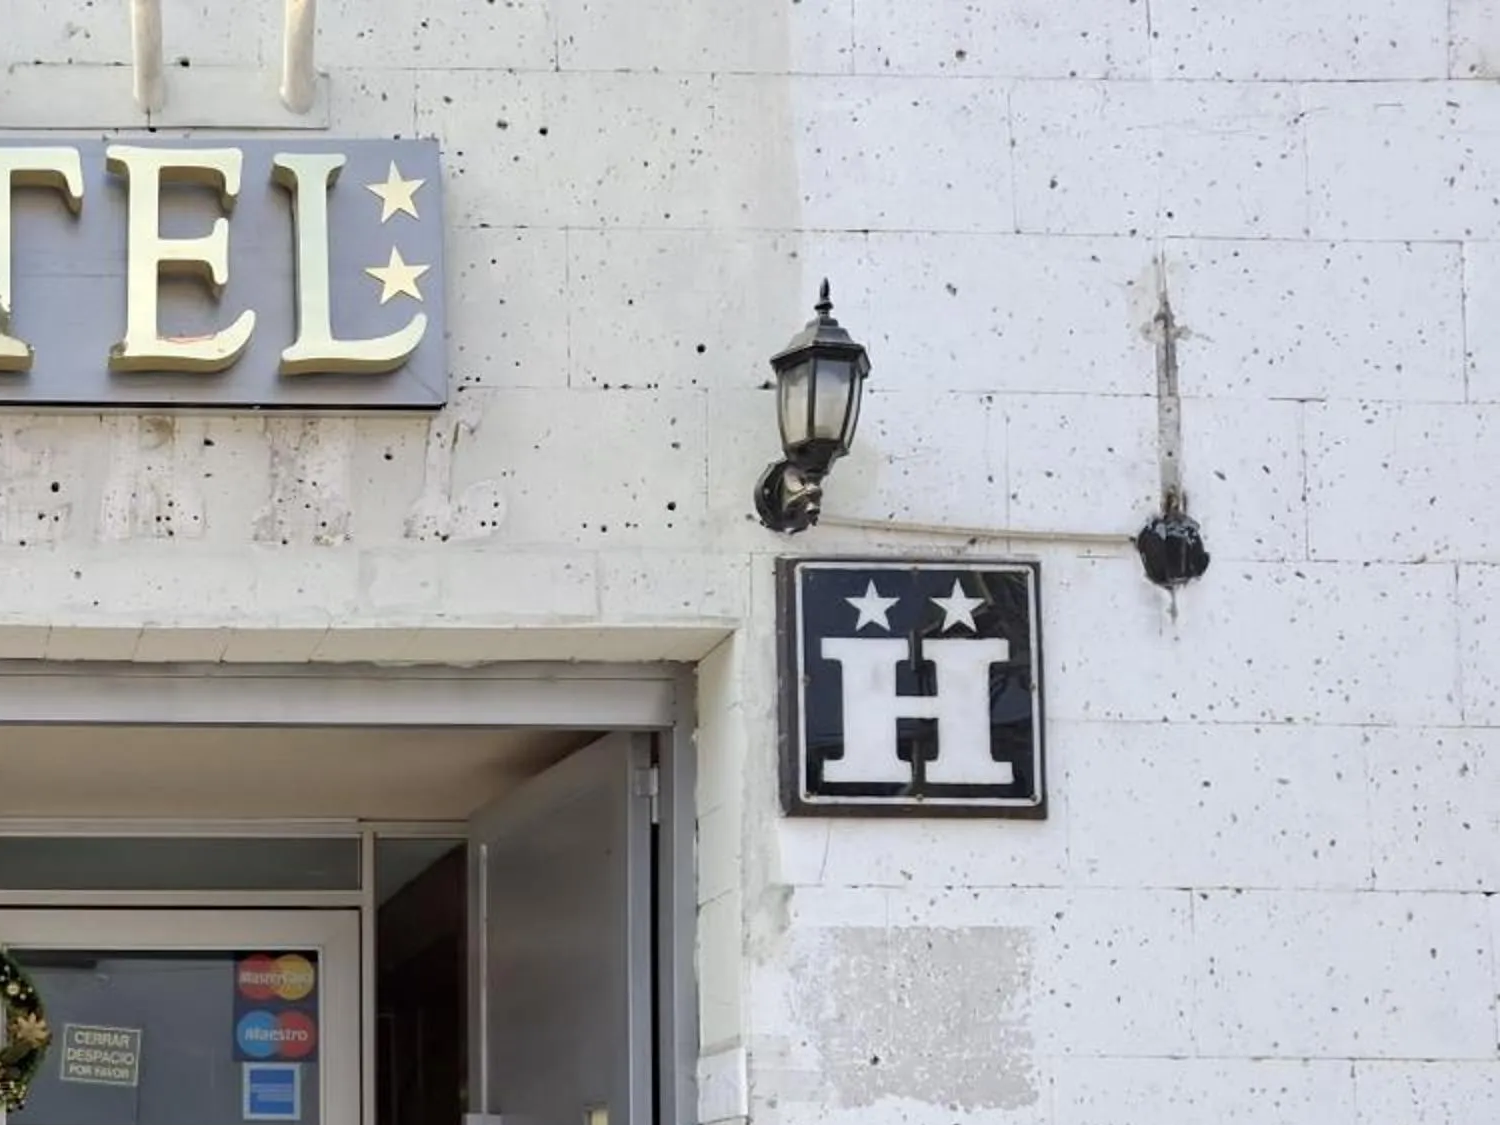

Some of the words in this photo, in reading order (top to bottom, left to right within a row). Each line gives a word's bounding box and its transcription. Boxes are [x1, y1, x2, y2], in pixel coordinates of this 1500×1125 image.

[819, 636, 1015, 785] H
[74, 1030, 132, 1049] CERRAR
[244, 1027, 309, 1041] Maestro
[67, 1047, 135, 1066] DESPACIO
[69, 1063, 92, 1076] POR
[94, 1066, 130, 1079] FAVOR
